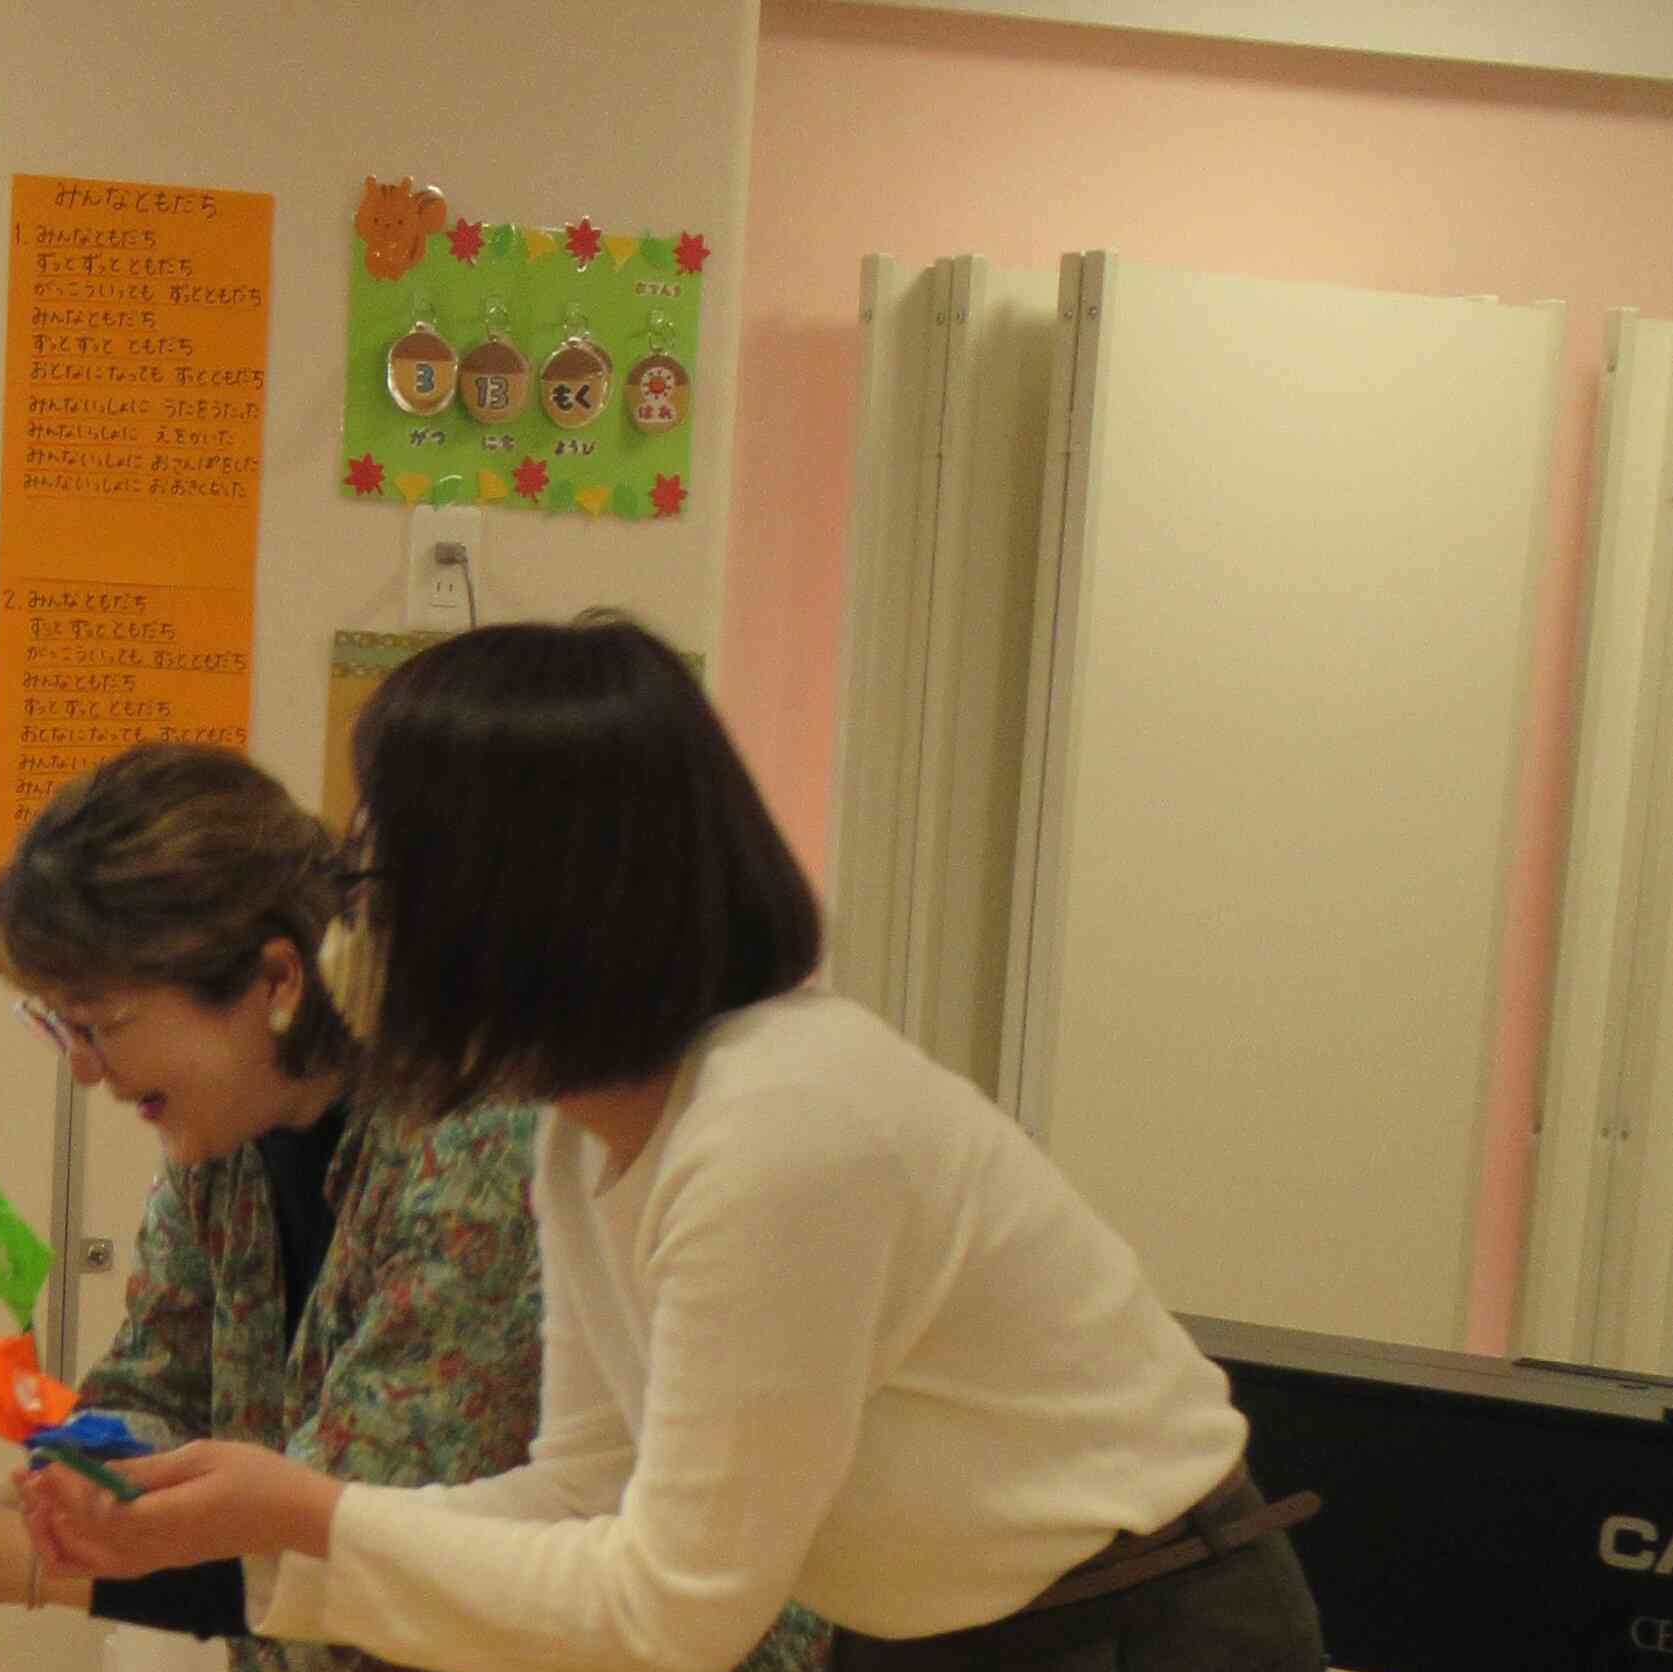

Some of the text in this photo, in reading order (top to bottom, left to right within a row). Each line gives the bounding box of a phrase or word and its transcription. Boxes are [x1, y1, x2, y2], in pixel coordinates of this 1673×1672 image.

[55, 187, 217, 219] みんなともだち
[37, 225, 156, 248] みんなともだち
[31, 308, 156, 328] みんなともだち
[416, 363, 592, 410] 3 13 もく
[639, 406, 671, 419] はれ
[409, 428, 595, 455] がつ にち ようび
[28, 590, 147, 613] みんなともだち
[23, 672, 136, 692] みんなともだち
[1599, 1515, 1673, 1574] C
